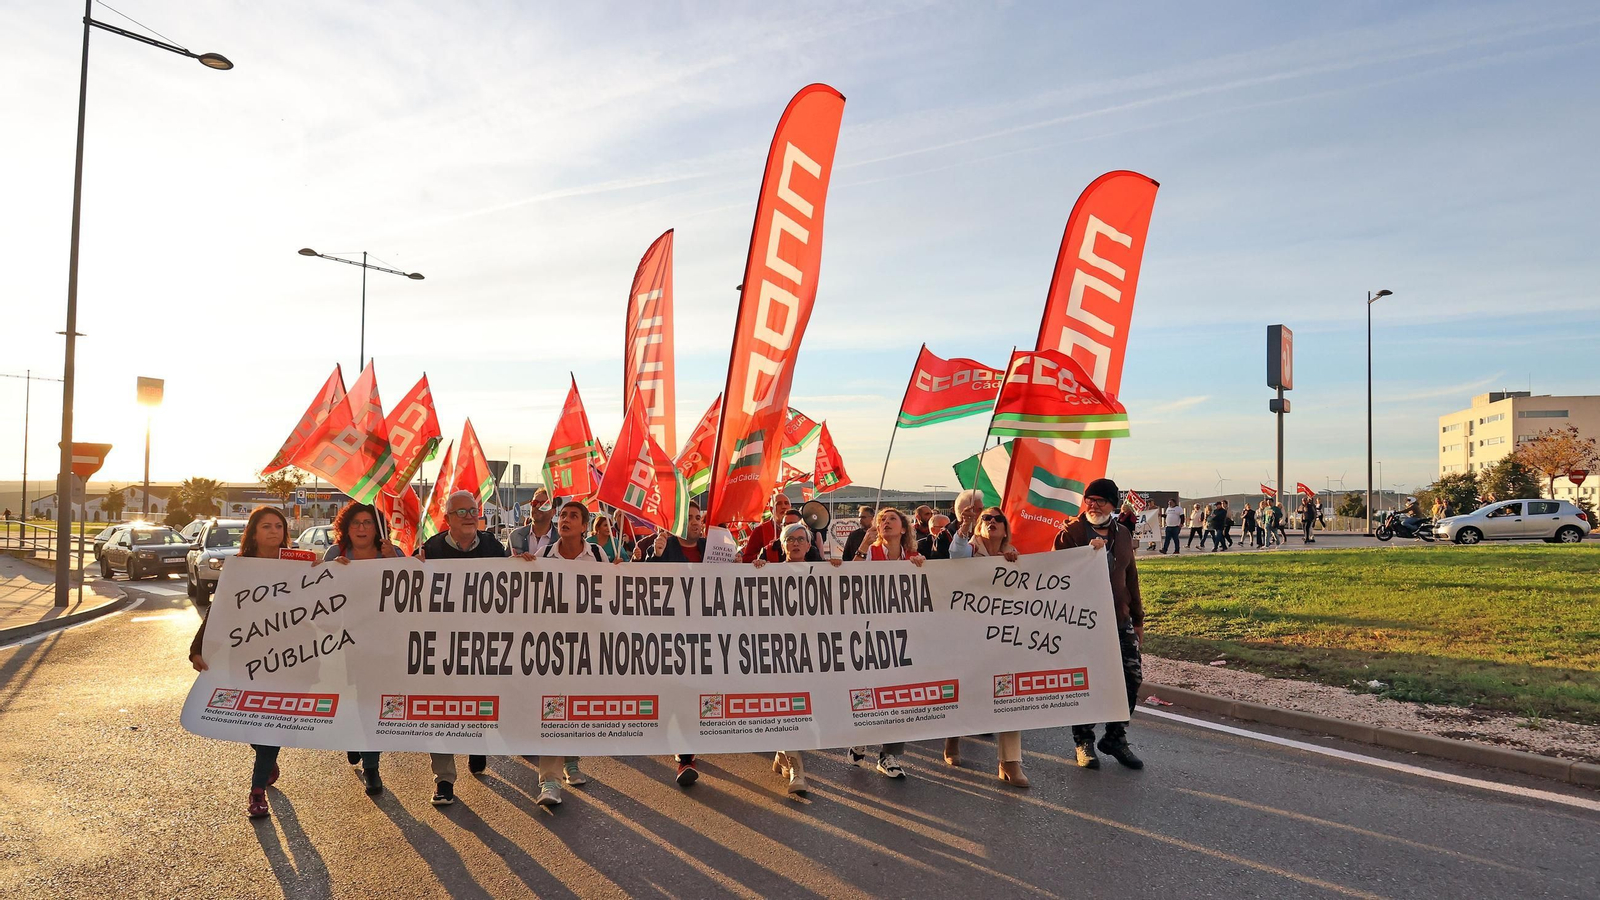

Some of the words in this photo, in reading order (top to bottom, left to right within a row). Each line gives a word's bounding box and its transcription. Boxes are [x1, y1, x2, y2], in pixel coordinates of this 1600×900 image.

[742, 141, 822, 416] CCOO
[916, 369, 993, 392] CCOO
[971, 380, 1001, 391] Cád
[1020, 509, 1053, 525] Sanidad
[992, 566, 1030, 590] POR
[1036, 574, 1071, 591] LOS
[235, 582, 291, 609] POR
[301, 568, 334, 589] LA
[379, 569, 424, 613] POR
[429, 573, 455, 613] EL
[462, 571, 569, 613] HOSPITAL
[576, 574, 602, 613] DE
[609, 576, 675, 617] JEREZ
[680, 577, 694, 616] Y
[701, 577, 727, 616] LA
[732, 566, 833, 616] ATENCIÓN
[839, 574, 934, 615] PRIMARIA
[950, 591, 1097, 630] PROFESIONALES
[229, 594, 347, 648] SANIDAD
[986, 625, 1022, 646] DEL
[1028, 630, 1061, 655] SAS
[246, 629, 355, 680] PÚBLICA
[407, 631, 437, 675] DE
[443, 631, 514, 675] JEREZ
[520, 631, 592, 676] COSTA
[599, 632, 712, 675] NOROESTE
[718, 634, 731, 675] Y
[739, 632, 813, 675] SIERRA
[818, 632, 845, 673] DE
[850, 621, 912, 671] CÁDIZ
[1019, 674, 1072, 691] CCOO
[244, 695, 315, 711] CCOO
[879, 686, 940, 704] CCOO
[993, 696, 1025, 705] federación
[413, 701, 476, 715] CCOO
[573, 701, 637, 715] CCOO
[730, 698, 790, 713] CCOO
[852, 711, 889, 719] federación
[932, 704, 959, 712] sectores
[994, 704, 1040, 713] sociosanitarios
[1050, 701, 1079, 709] Andalucía
[201, 715, 262, 727] sociosanitarios
[275, 722, 315, 731] Andalucía
[204, 708, 247, 718] federación
[300, 716, 333, 724] sectores
[700, 719, 736, 727] federación
[854, 718, 905, 727] sociosanitarios
[915, 713, 946, 721] Andalucía
[541, 730, 596, 738] sociosanitarios
[700, 727, 753, 736] sociosanitarios
[764, 725, 799, 733] Andalucía
